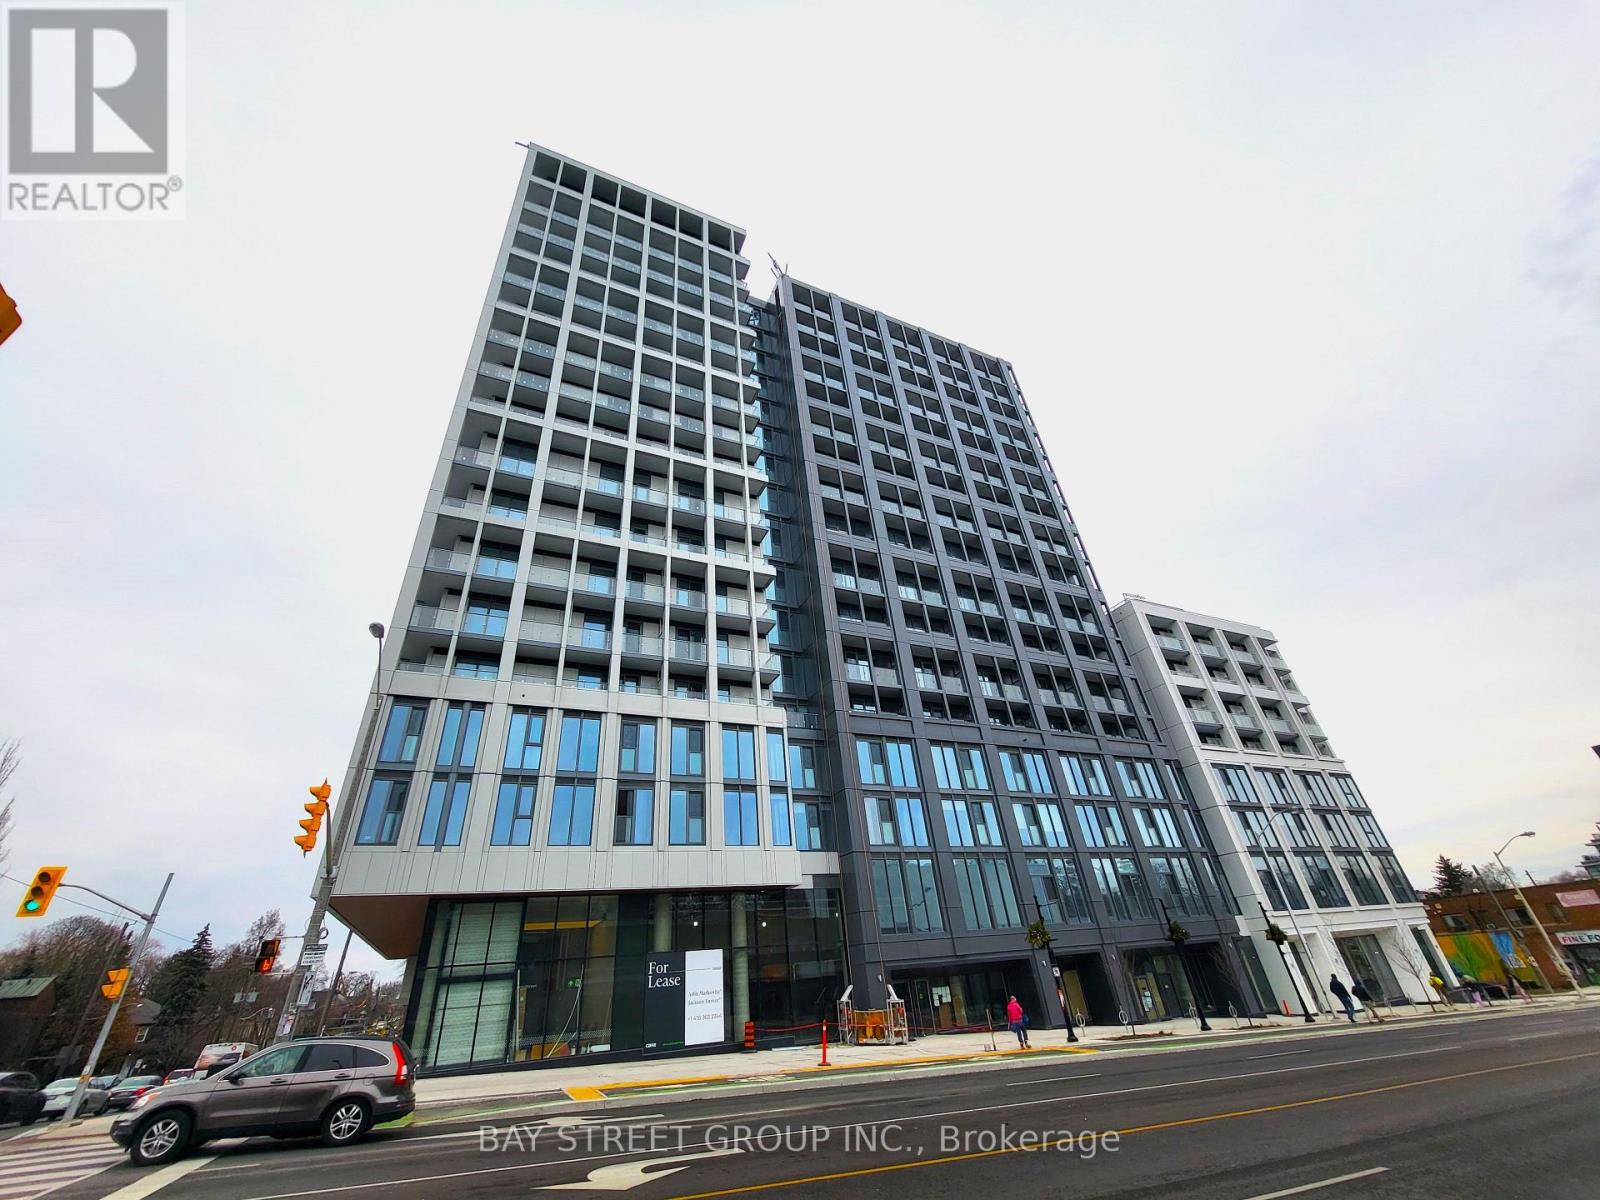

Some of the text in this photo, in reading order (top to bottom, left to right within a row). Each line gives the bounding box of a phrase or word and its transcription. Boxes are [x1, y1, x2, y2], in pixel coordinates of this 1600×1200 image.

[1562, 935, 1587, 944] FINE
[648, 961, 669, 975] For
[648, 975, 681, 989] Lease
